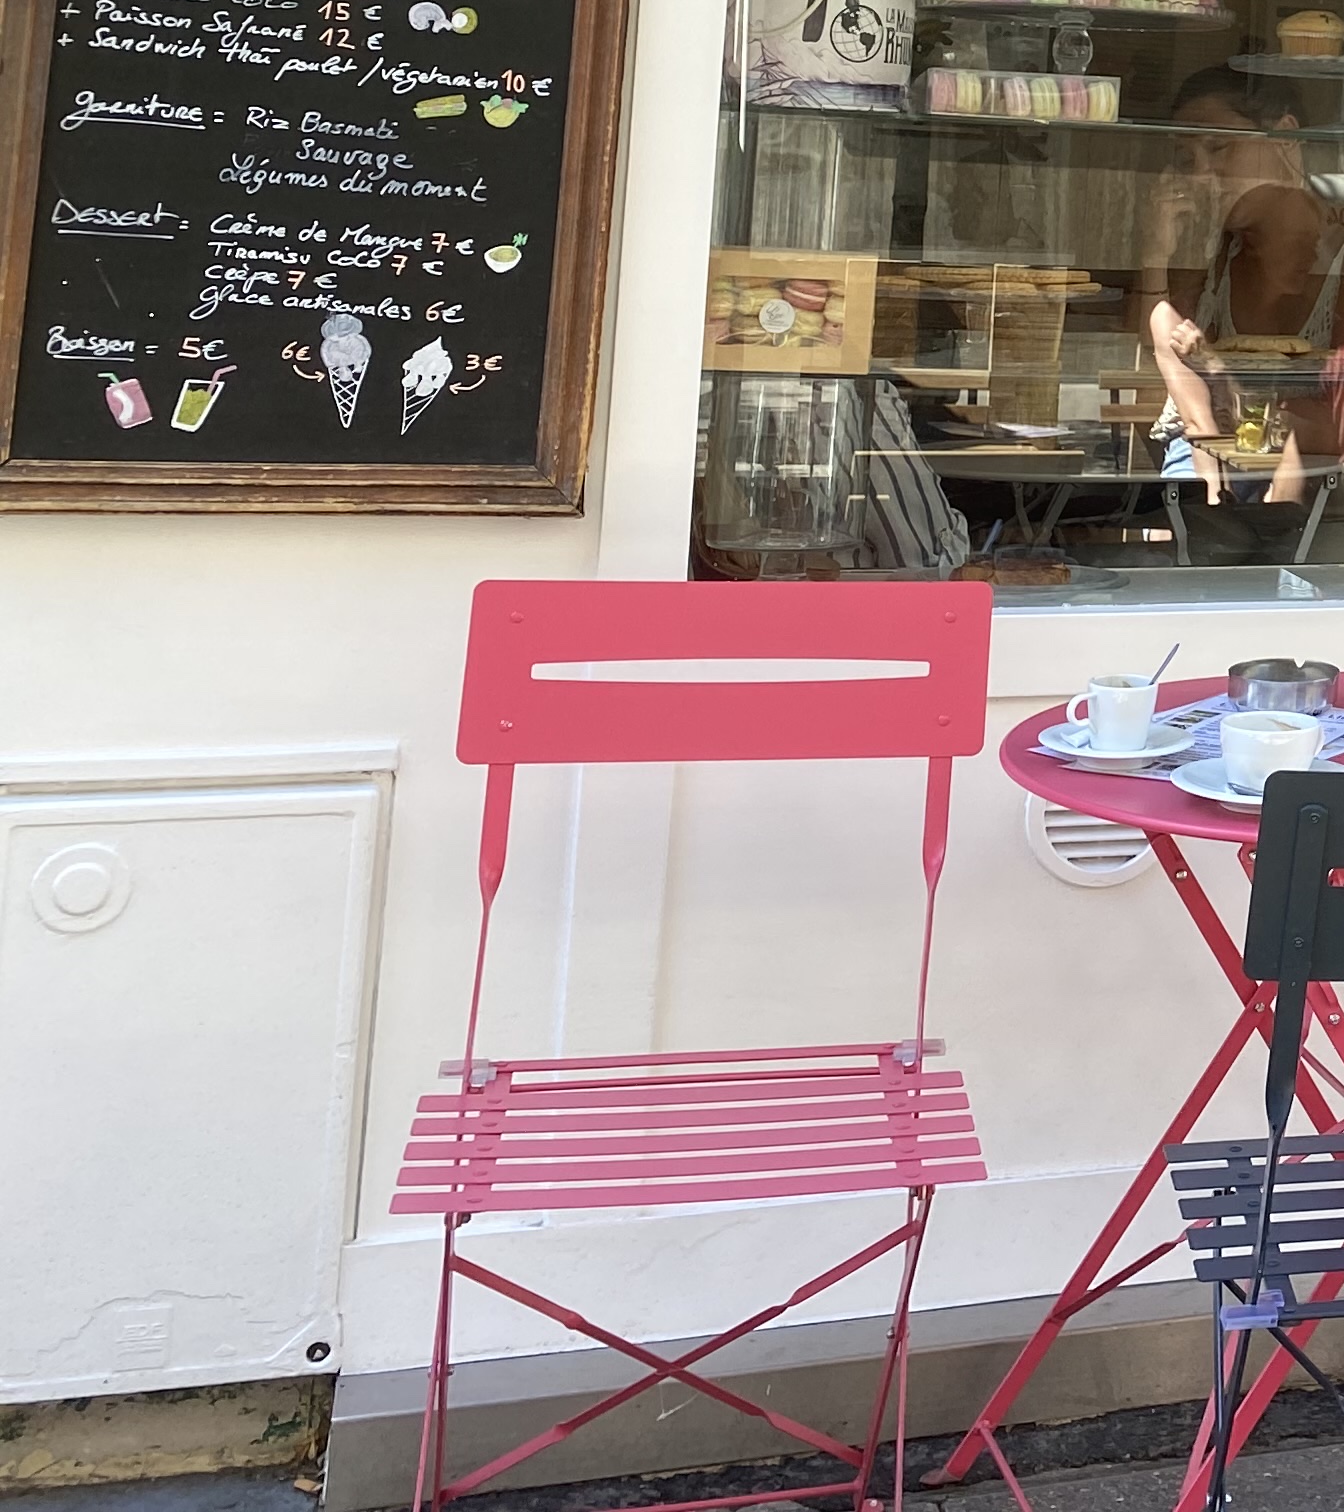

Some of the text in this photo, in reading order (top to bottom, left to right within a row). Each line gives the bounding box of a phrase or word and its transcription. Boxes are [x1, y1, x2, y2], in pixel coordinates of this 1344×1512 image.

[292, 138, 413, 181] Sauvage
[338, 169, 375, 193] du
[379, 170, 487, 201] moment
[297, 219, 327, 242] de
